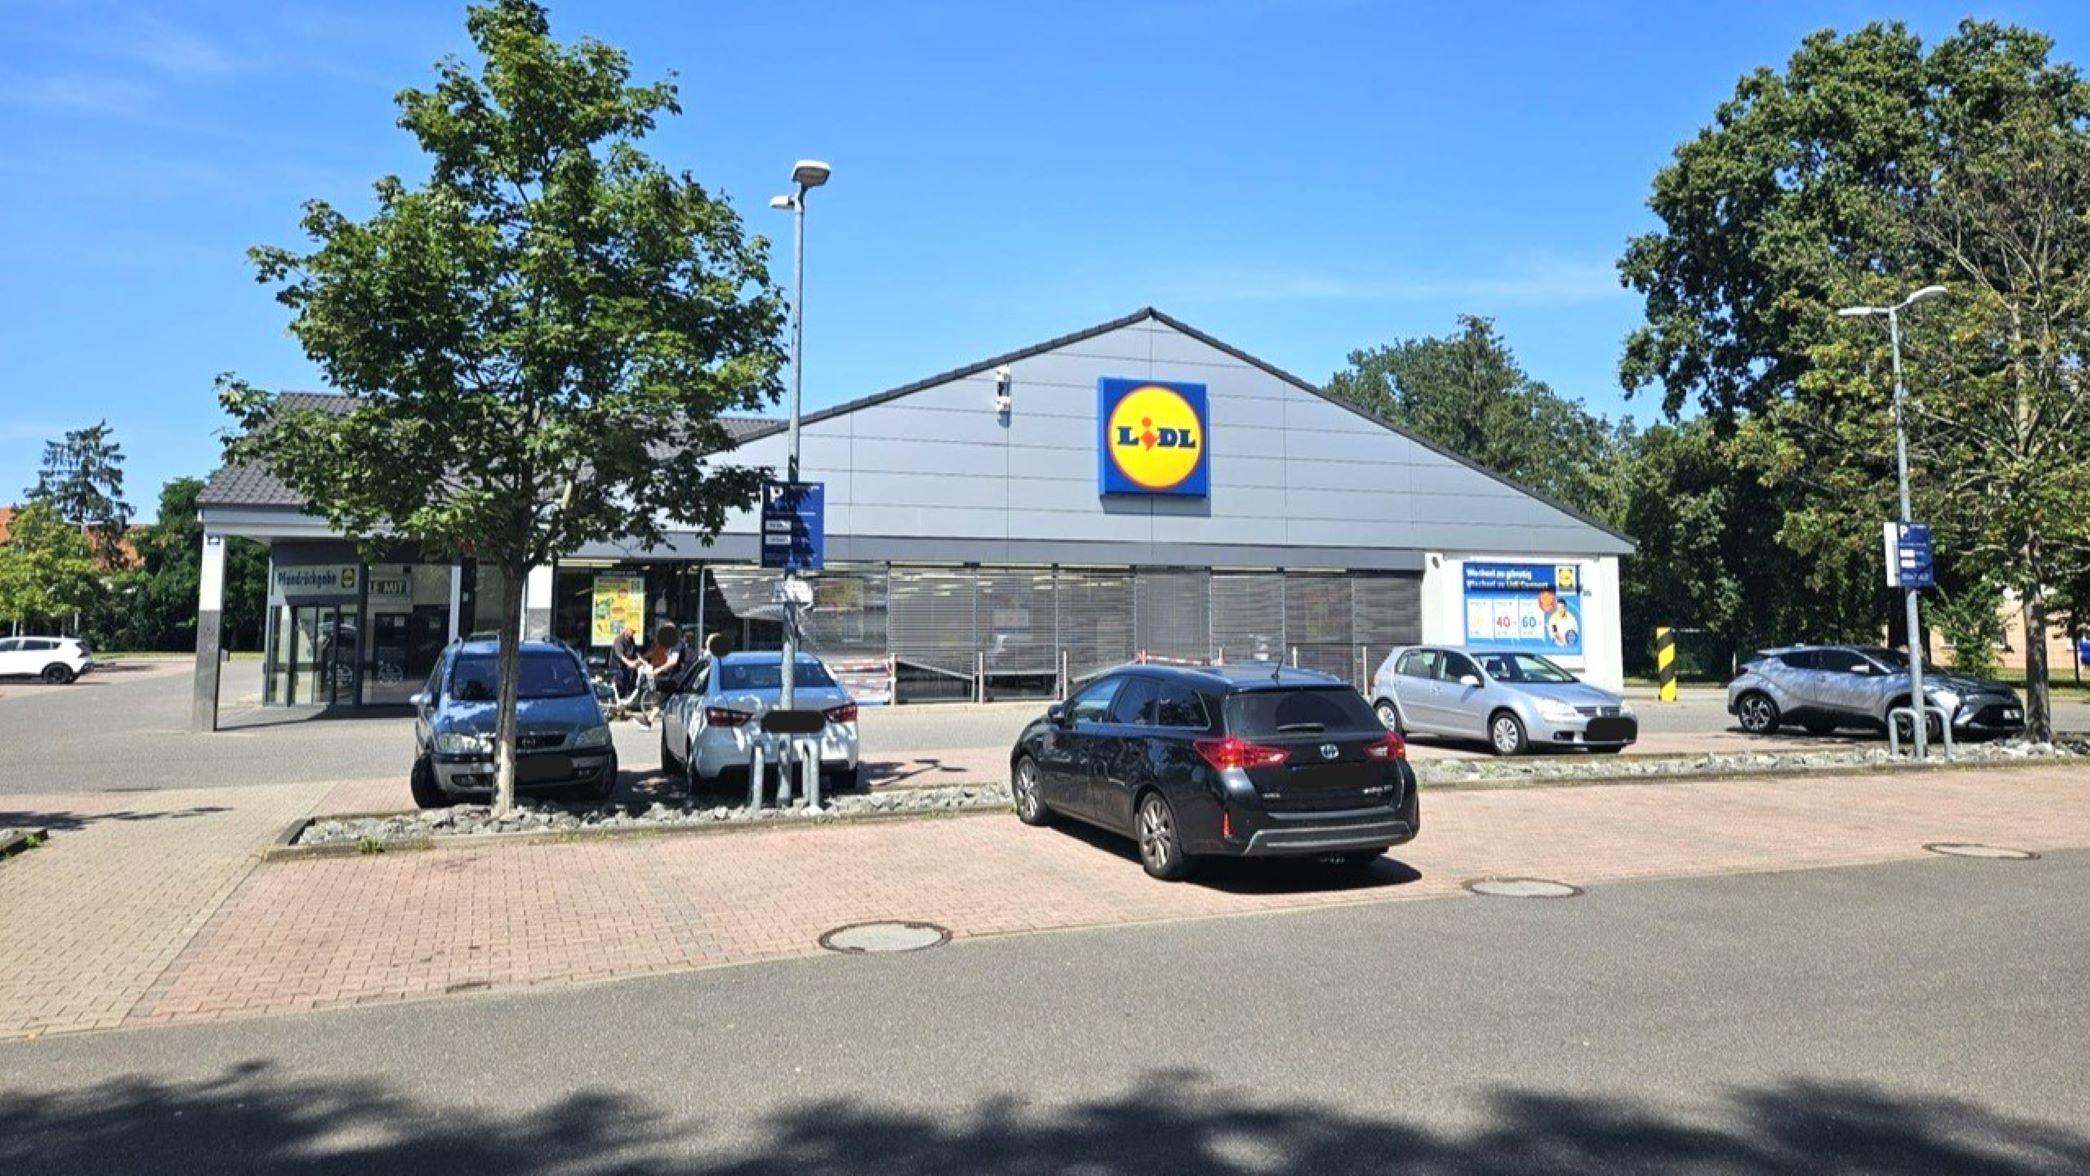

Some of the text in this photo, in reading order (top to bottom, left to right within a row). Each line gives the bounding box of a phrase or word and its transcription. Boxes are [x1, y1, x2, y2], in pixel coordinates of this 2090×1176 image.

[769, 485, 784, 503] P
[1496, 616, 1511, 628] 40
[1522, 616, 1537, 628] 60
